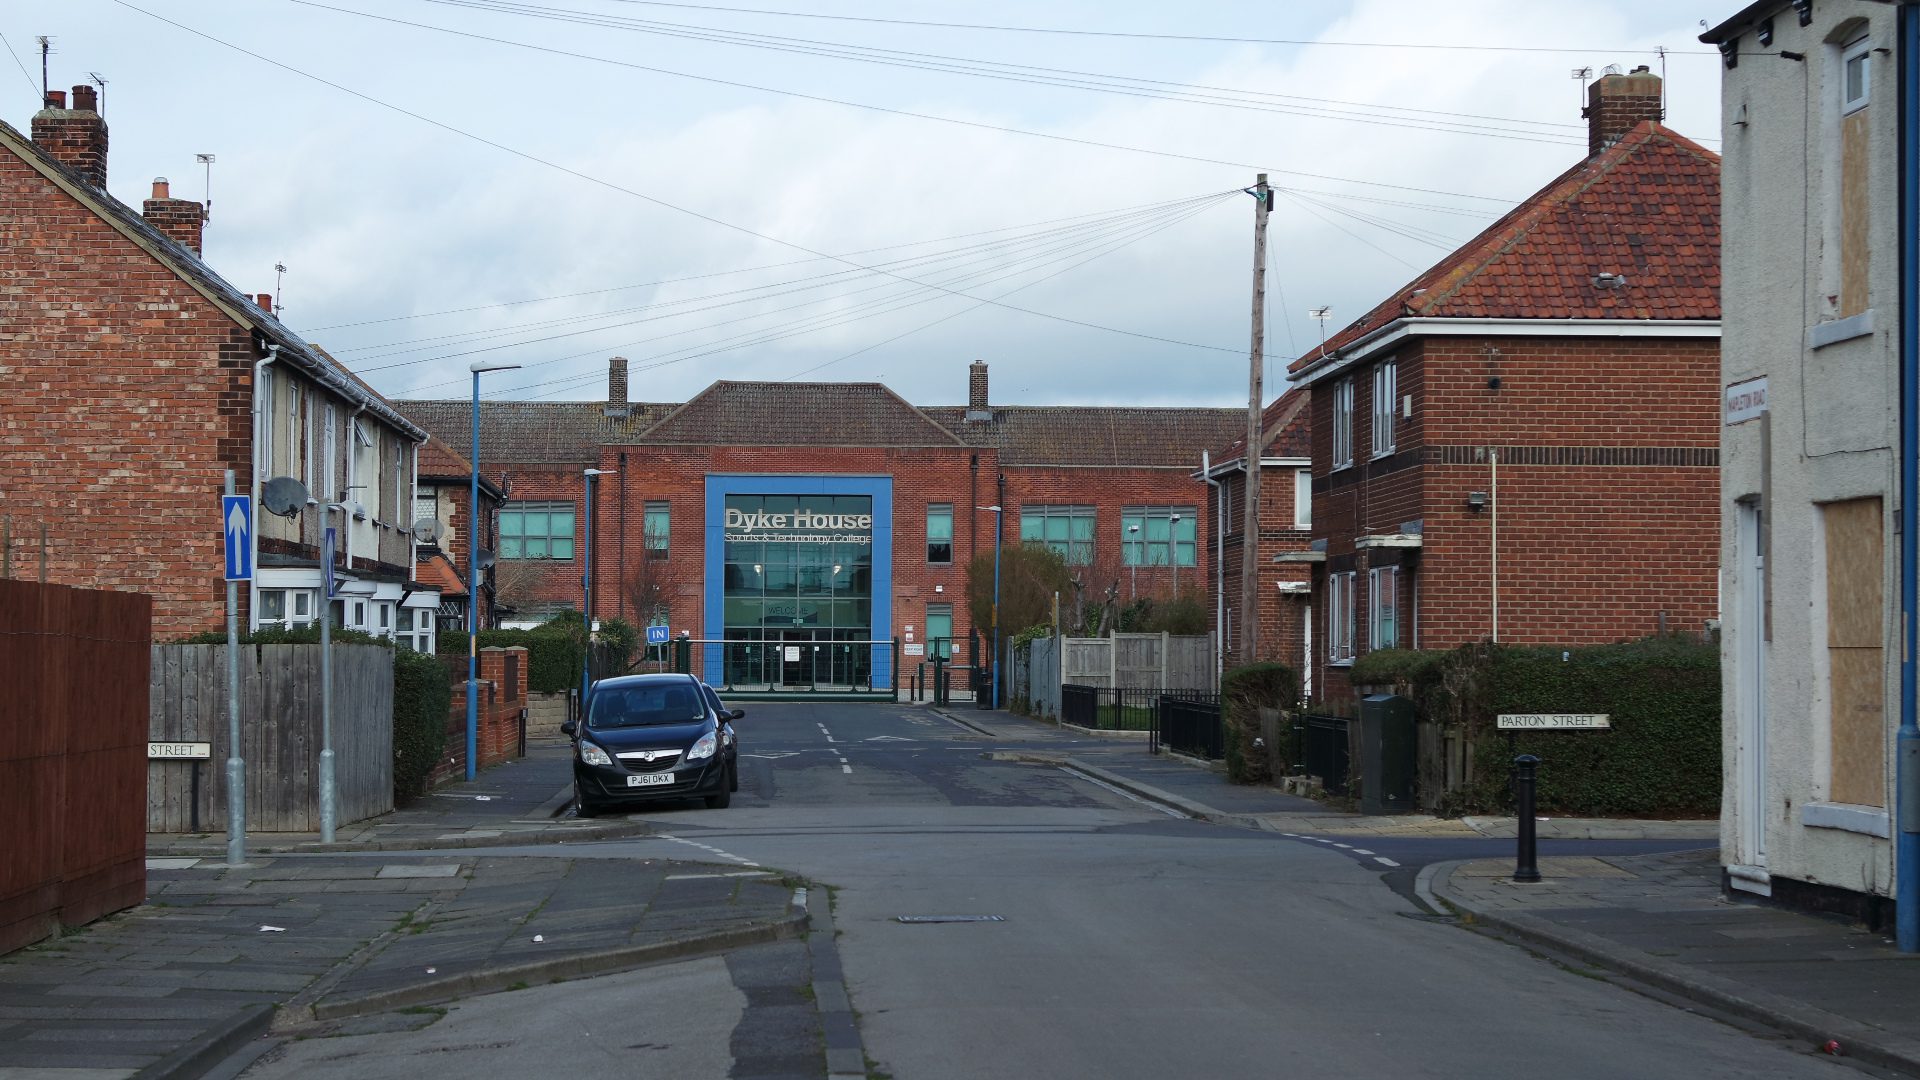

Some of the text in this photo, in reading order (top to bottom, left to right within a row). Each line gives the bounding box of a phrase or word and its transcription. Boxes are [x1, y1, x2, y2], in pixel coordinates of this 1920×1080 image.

[1728, 389, 1765, 412] MAPLETON ROAD
[726, 508, 872, 532] Dyke House
[725, 533, 872, 545] Sports & Technology College
[652, 629, 665, 639] IN
[1502, 715, 1595, 726] PARTON STREET
[150, 744, 195, 756] STREET
[631, 774, 669, 785] PJ61 OKX
